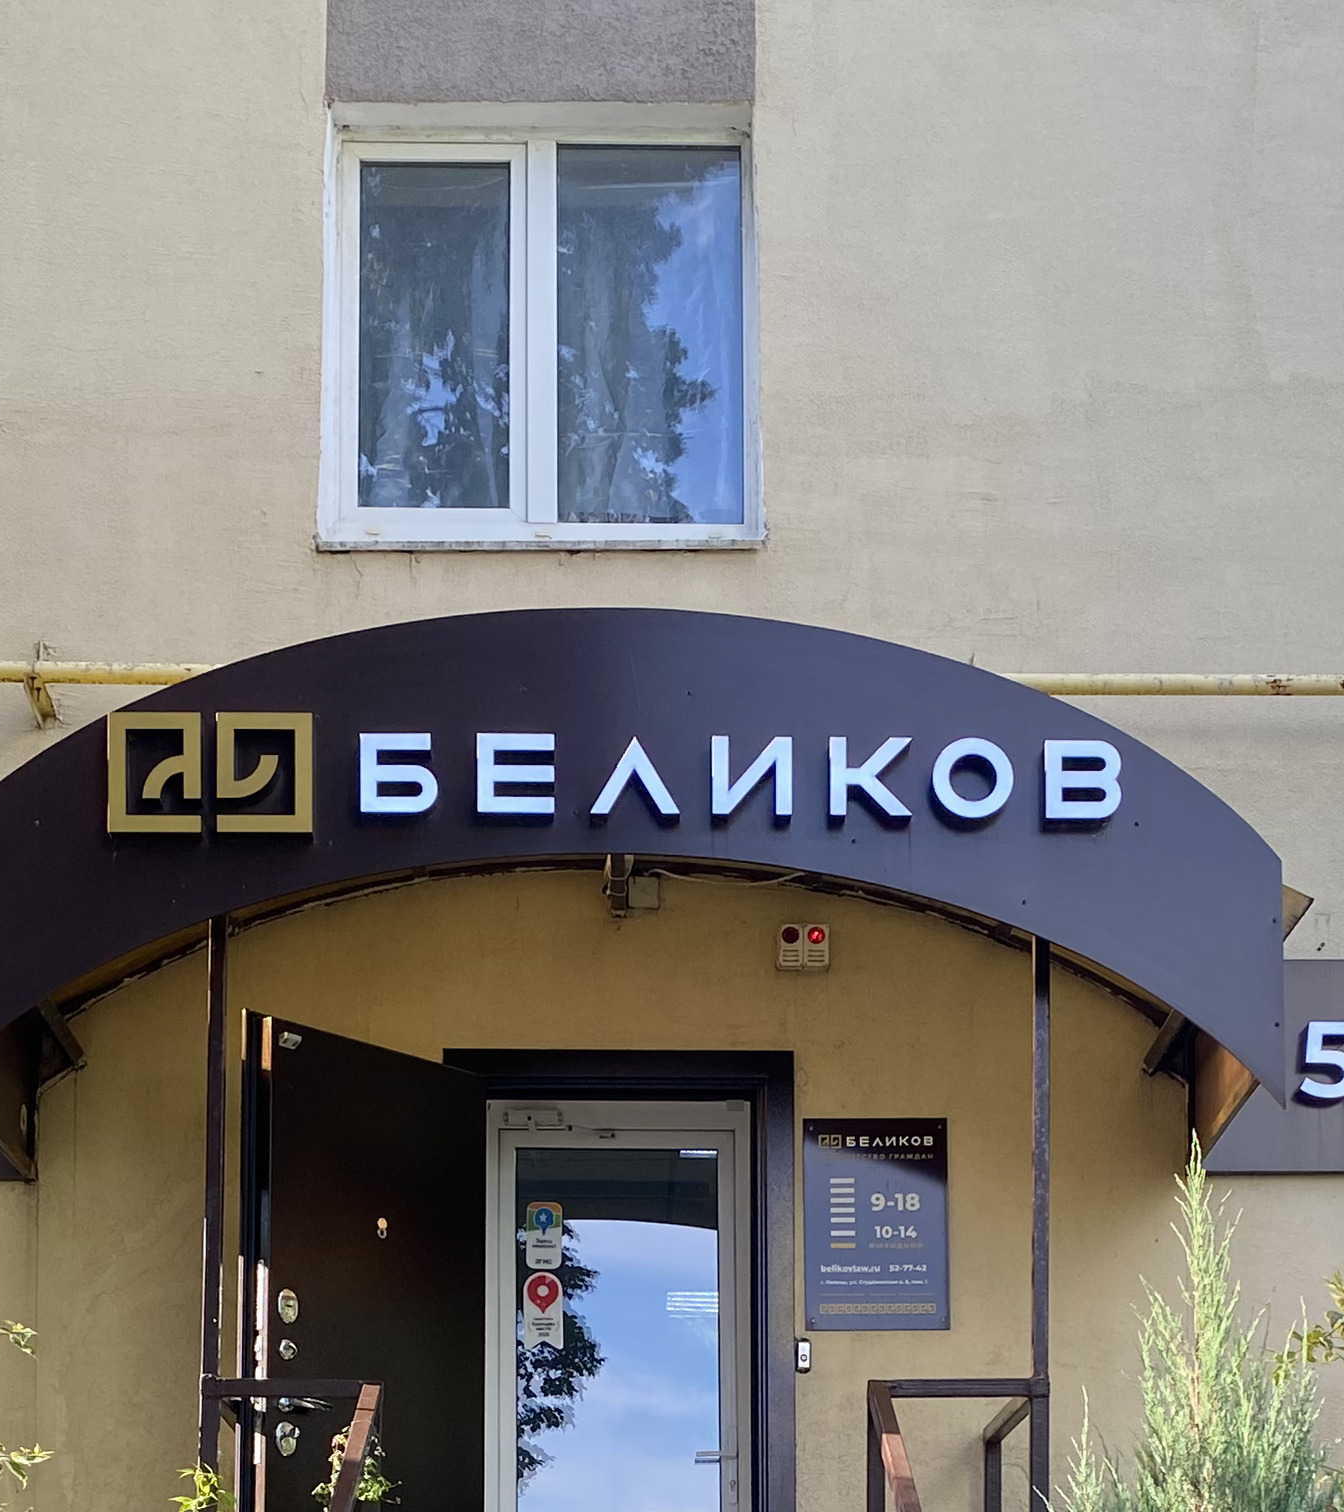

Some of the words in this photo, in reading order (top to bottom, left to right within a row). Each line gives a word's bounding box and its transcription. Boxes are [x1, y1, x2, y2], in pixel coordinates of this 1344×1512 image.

[359, 732, 1122, 821] БЕЛИКОВ
[846, 1136, 934, 1147] БЕЛИКОВ
[888, 1153, 934, 1161] ГРАЖДАН
[870, 1193, 921, 1211] 9-18
[874, 1226, 918, 1239] 10-14
[820, 1264, 881, 1273] belikovlaw.ru
[889, 1264, 927, 1272] 52-77-42
